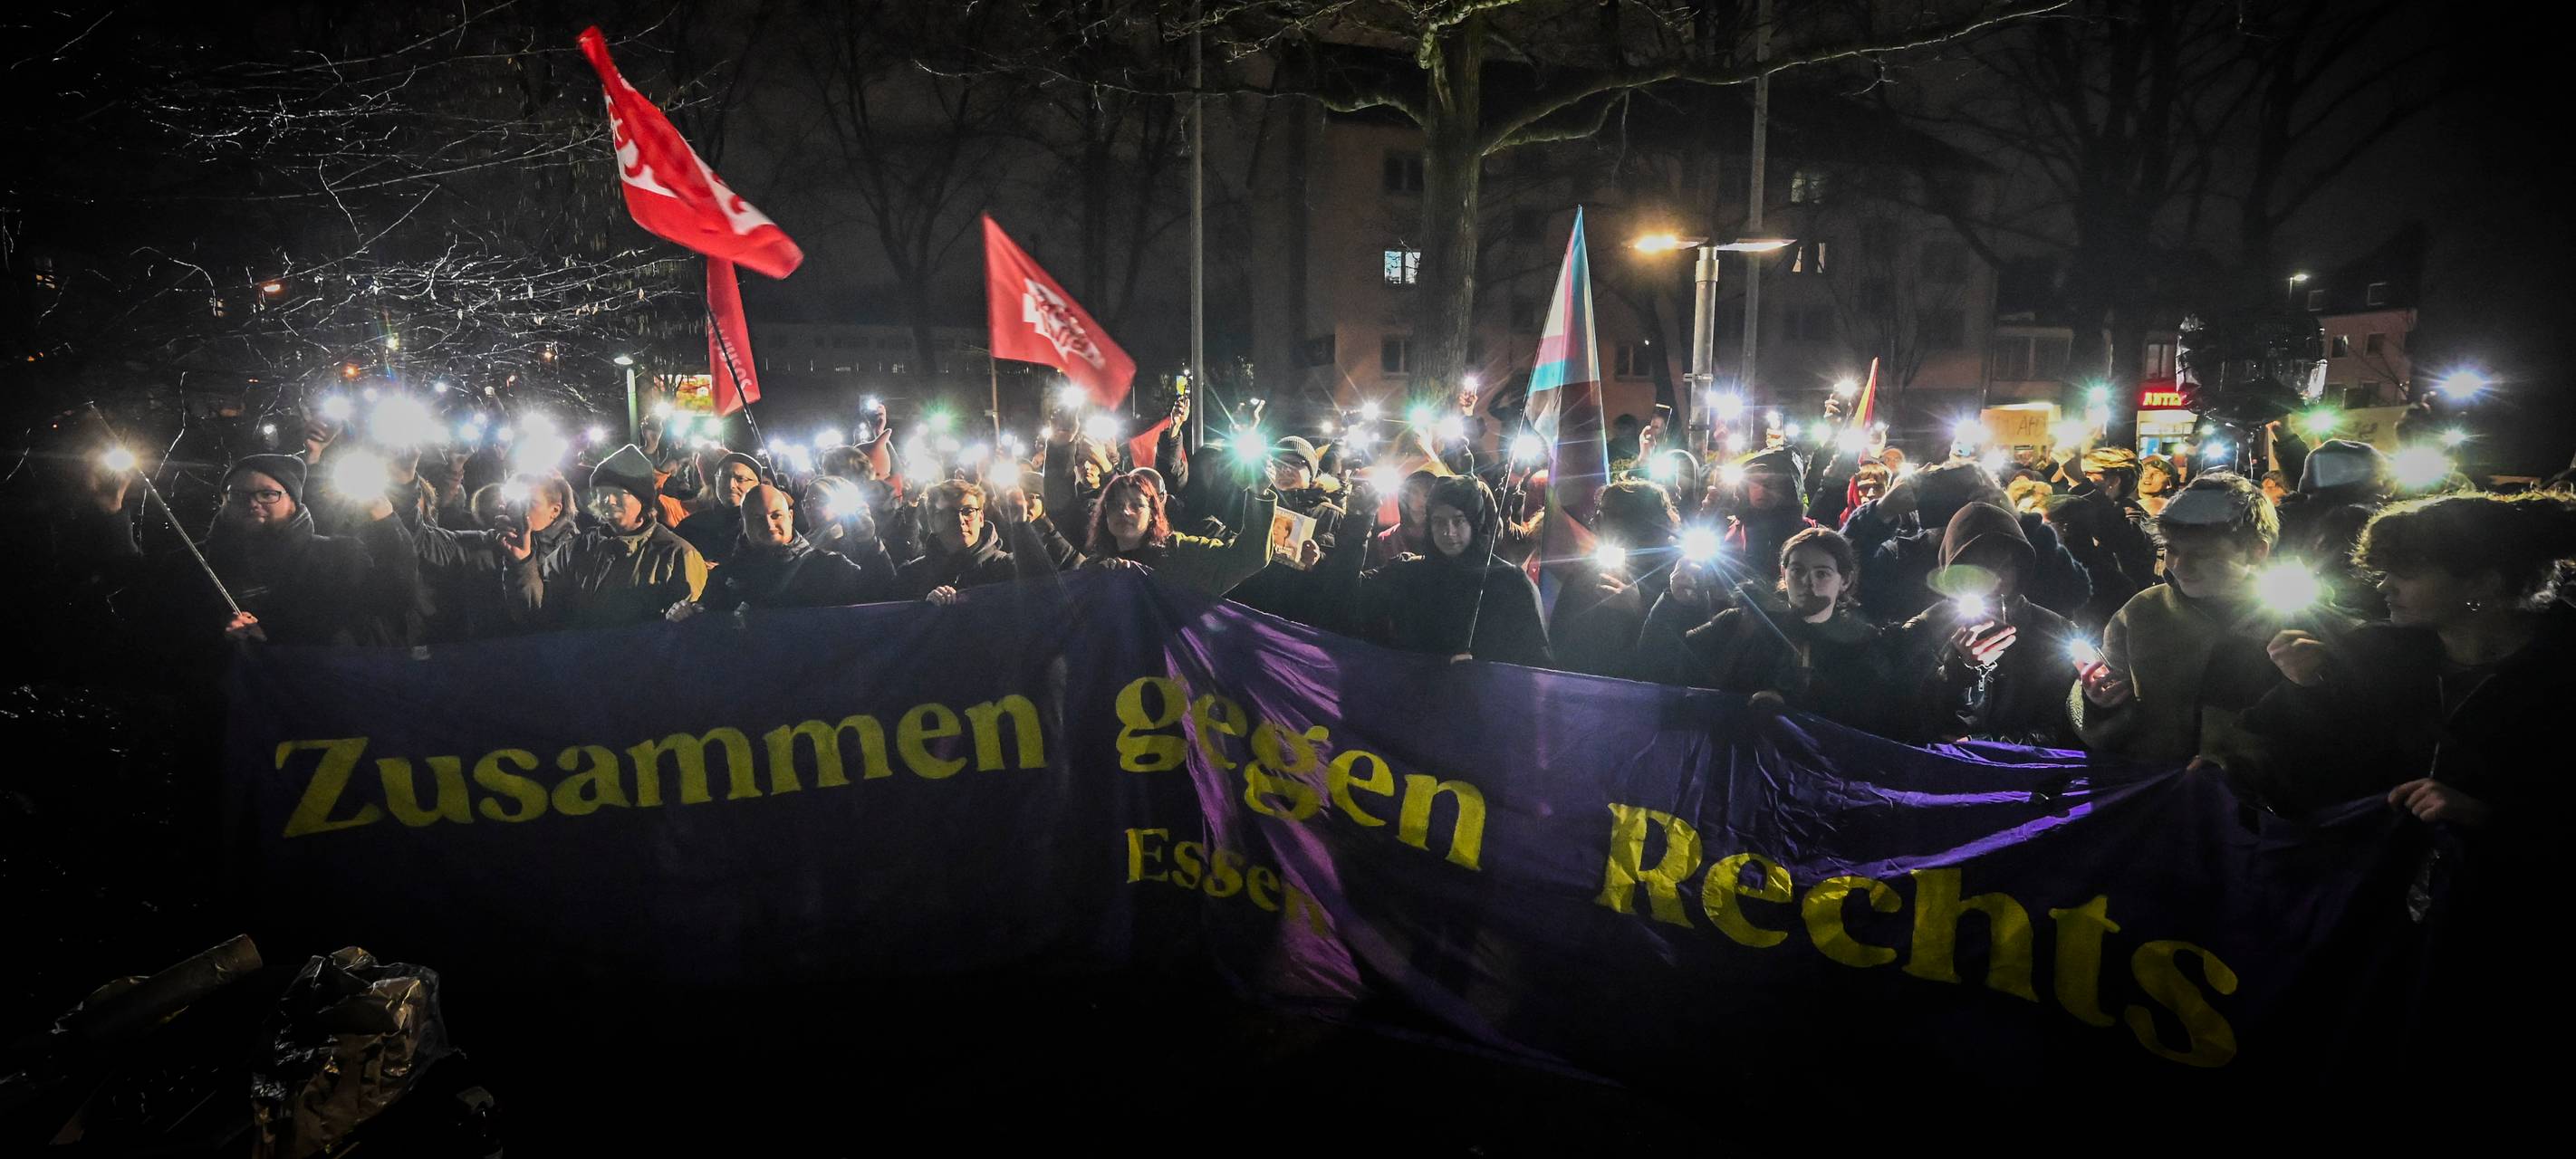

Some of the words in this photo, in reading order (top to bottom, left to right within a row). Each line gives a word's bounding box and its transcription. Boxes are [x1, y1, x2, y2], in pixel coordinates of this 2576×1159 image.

[274, 694, 1045, 838] Zusammen
[1116, 675, 1486, 871] gegen
[1593, 802, 2239, 1068] Rechts
[1125, 828, 1331, 936] Essen
